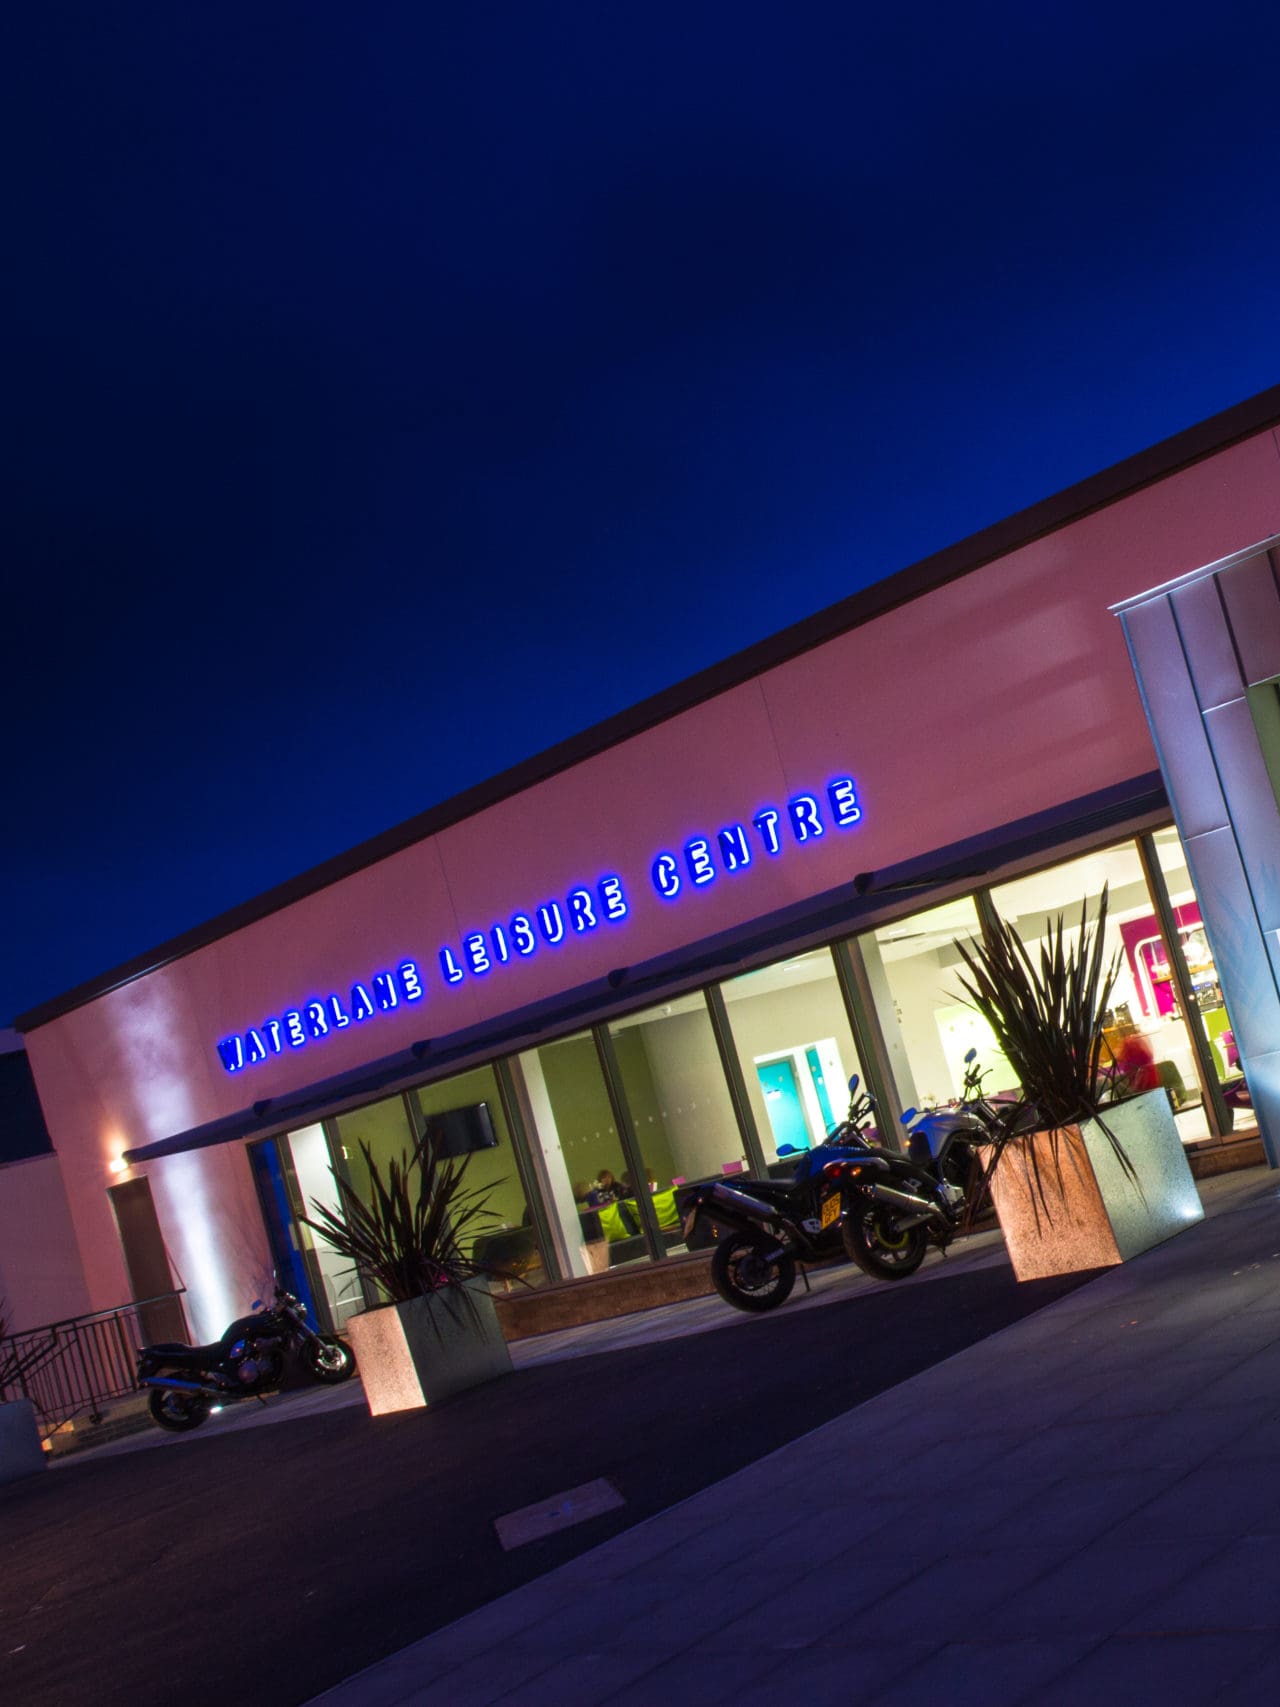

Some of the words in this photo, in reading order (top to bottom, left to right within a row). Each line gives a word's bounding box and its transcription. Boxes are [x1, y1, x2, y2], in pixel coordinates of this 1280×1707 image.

[217, 963, 422, 1071] WATERLANE
[439, 878, 627, 983] LEISURE
[652, 779, 861, 896] CENTRE
